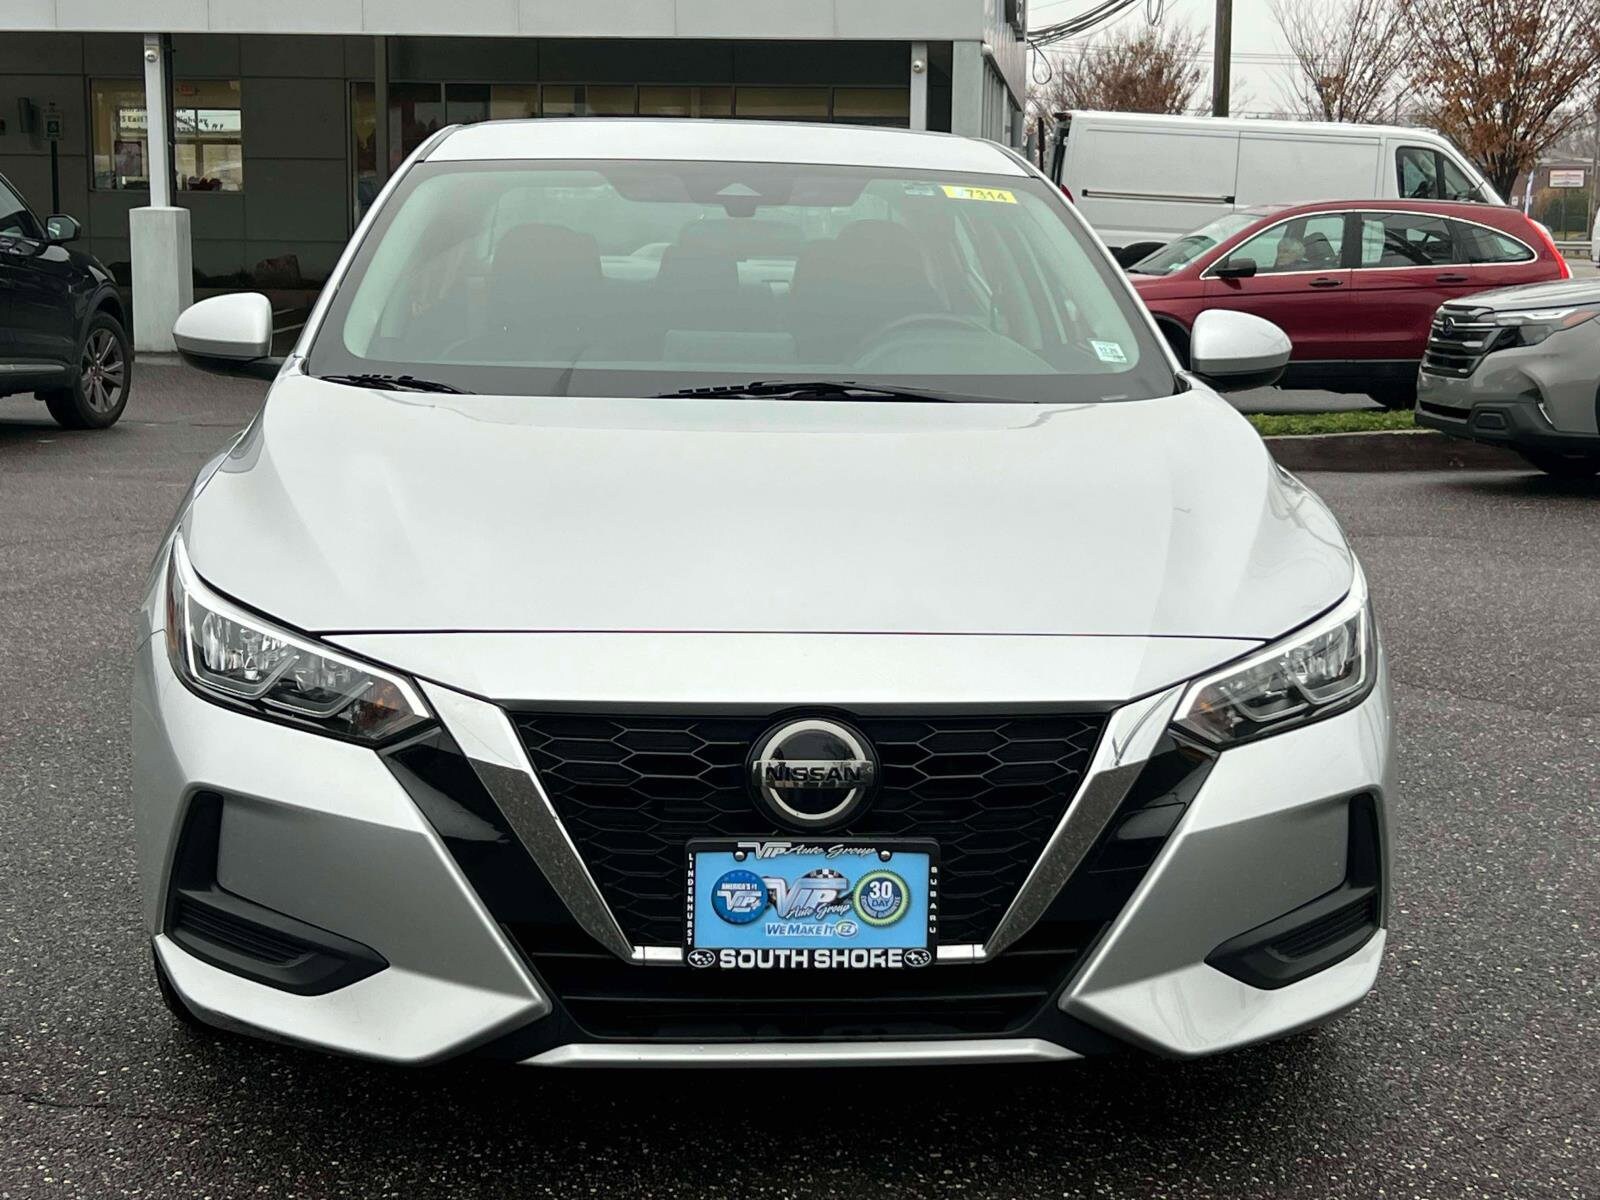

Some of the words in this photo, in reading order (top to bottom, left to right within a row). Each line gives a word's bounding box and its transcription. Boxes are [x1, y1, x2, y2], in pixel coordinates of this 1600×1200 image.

[765, 766, 861, 781] NISSAN
[737, 841, 792, 859] VIP
[784, 844, 826, 855] Auto
[826, 844, 877, 858] Group
[686, 852, 694, 945] LINDENHURST
[762, 877, 848, 918] VIP
[869, 880, 893, 899] 30
[871, 899, 890, 907] DAY
[929, 866, 938, 934] SUBARU
[719, 949, 808, 969] SOUTH
[814, 949, 903, 969] SHORE
